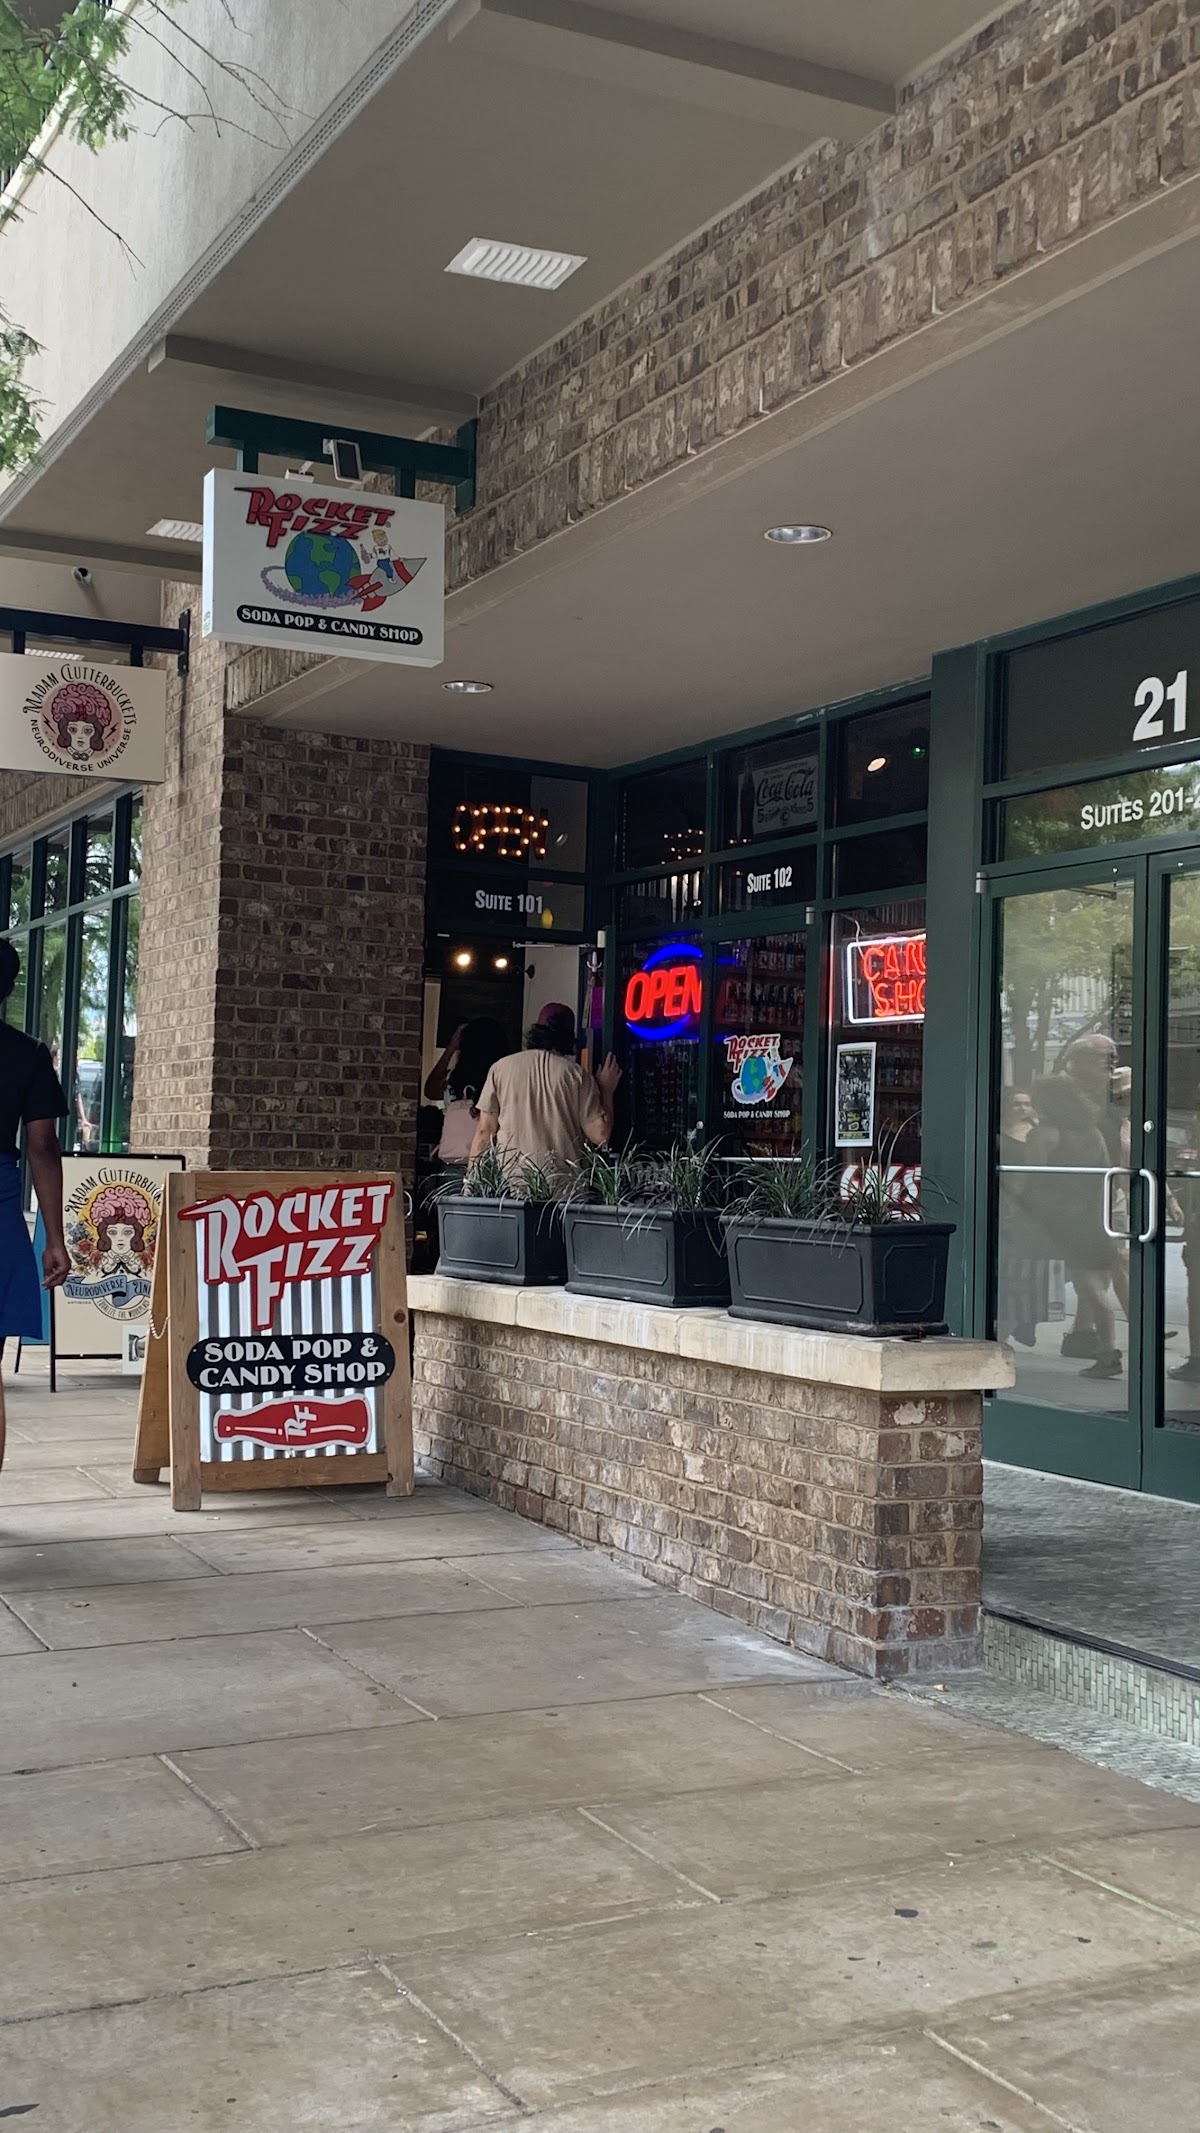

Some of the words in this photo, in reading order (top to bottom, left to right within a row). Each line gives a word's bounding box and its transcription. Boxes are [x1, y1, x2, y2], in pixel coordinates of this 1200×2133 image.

[234, 487, 396, 526] ROCKET
[266, 511, 369, 548] FIZZ
[241, 608, 281, 625] SODA
[284, 615, 315, 628] POP
[318, 617, 327, 630] &
[331, 620, 377, 637] CANDY
[379, 627, 419, 642] SHOP
[22, 671, 60, 715] MADAM
[60, 663, 137, 726] CLUTTERBUCKETS
[1132, 669, 1188, 742] 21
[30, 719, 94, 772] NEURODIVERSE
[97, 728, 132, 769] UNIVERSE
[451, 801, 549, 861] OPEN
[1080, 799, 1144, 831] SUITES
[747, 872, 771, 894] SUITE
[774, 866, 793, 889] 102
[475, 890, 512, 911] SUITE
[517, 893, 543, 914] 101
[863, 942, 926, 981] CAN
[625, 965, 702, 1021] OPEN
[874, 979, 926, 1017] SH
[724, 1035, 780, 1060] ROCKET
[734, 1047, 770, 1072] FIZZ
[723, 1110, 737, 1119] SODA
[738, 1110, 750, 1119] POP
[755, 1110, 773, 1118] CANDY
[774, 1109, 791, 1118] SHOP
[64, 1175, 98, 1216] MADAM
[183, 1185, 392, 1281] ROCKET
[65, 1279, 124, 1297] NEURODIVERSE
[237, 1234, 377, 1326] FIZZ
[204, 1341, 284, 1363] SODA
[292, 1338, 352, 1359] POP
[360, 1337, 379, 1357] &
[199, 1365, 296, 1388] CANDY
[304, 1361, 386, 1384] SHOP
